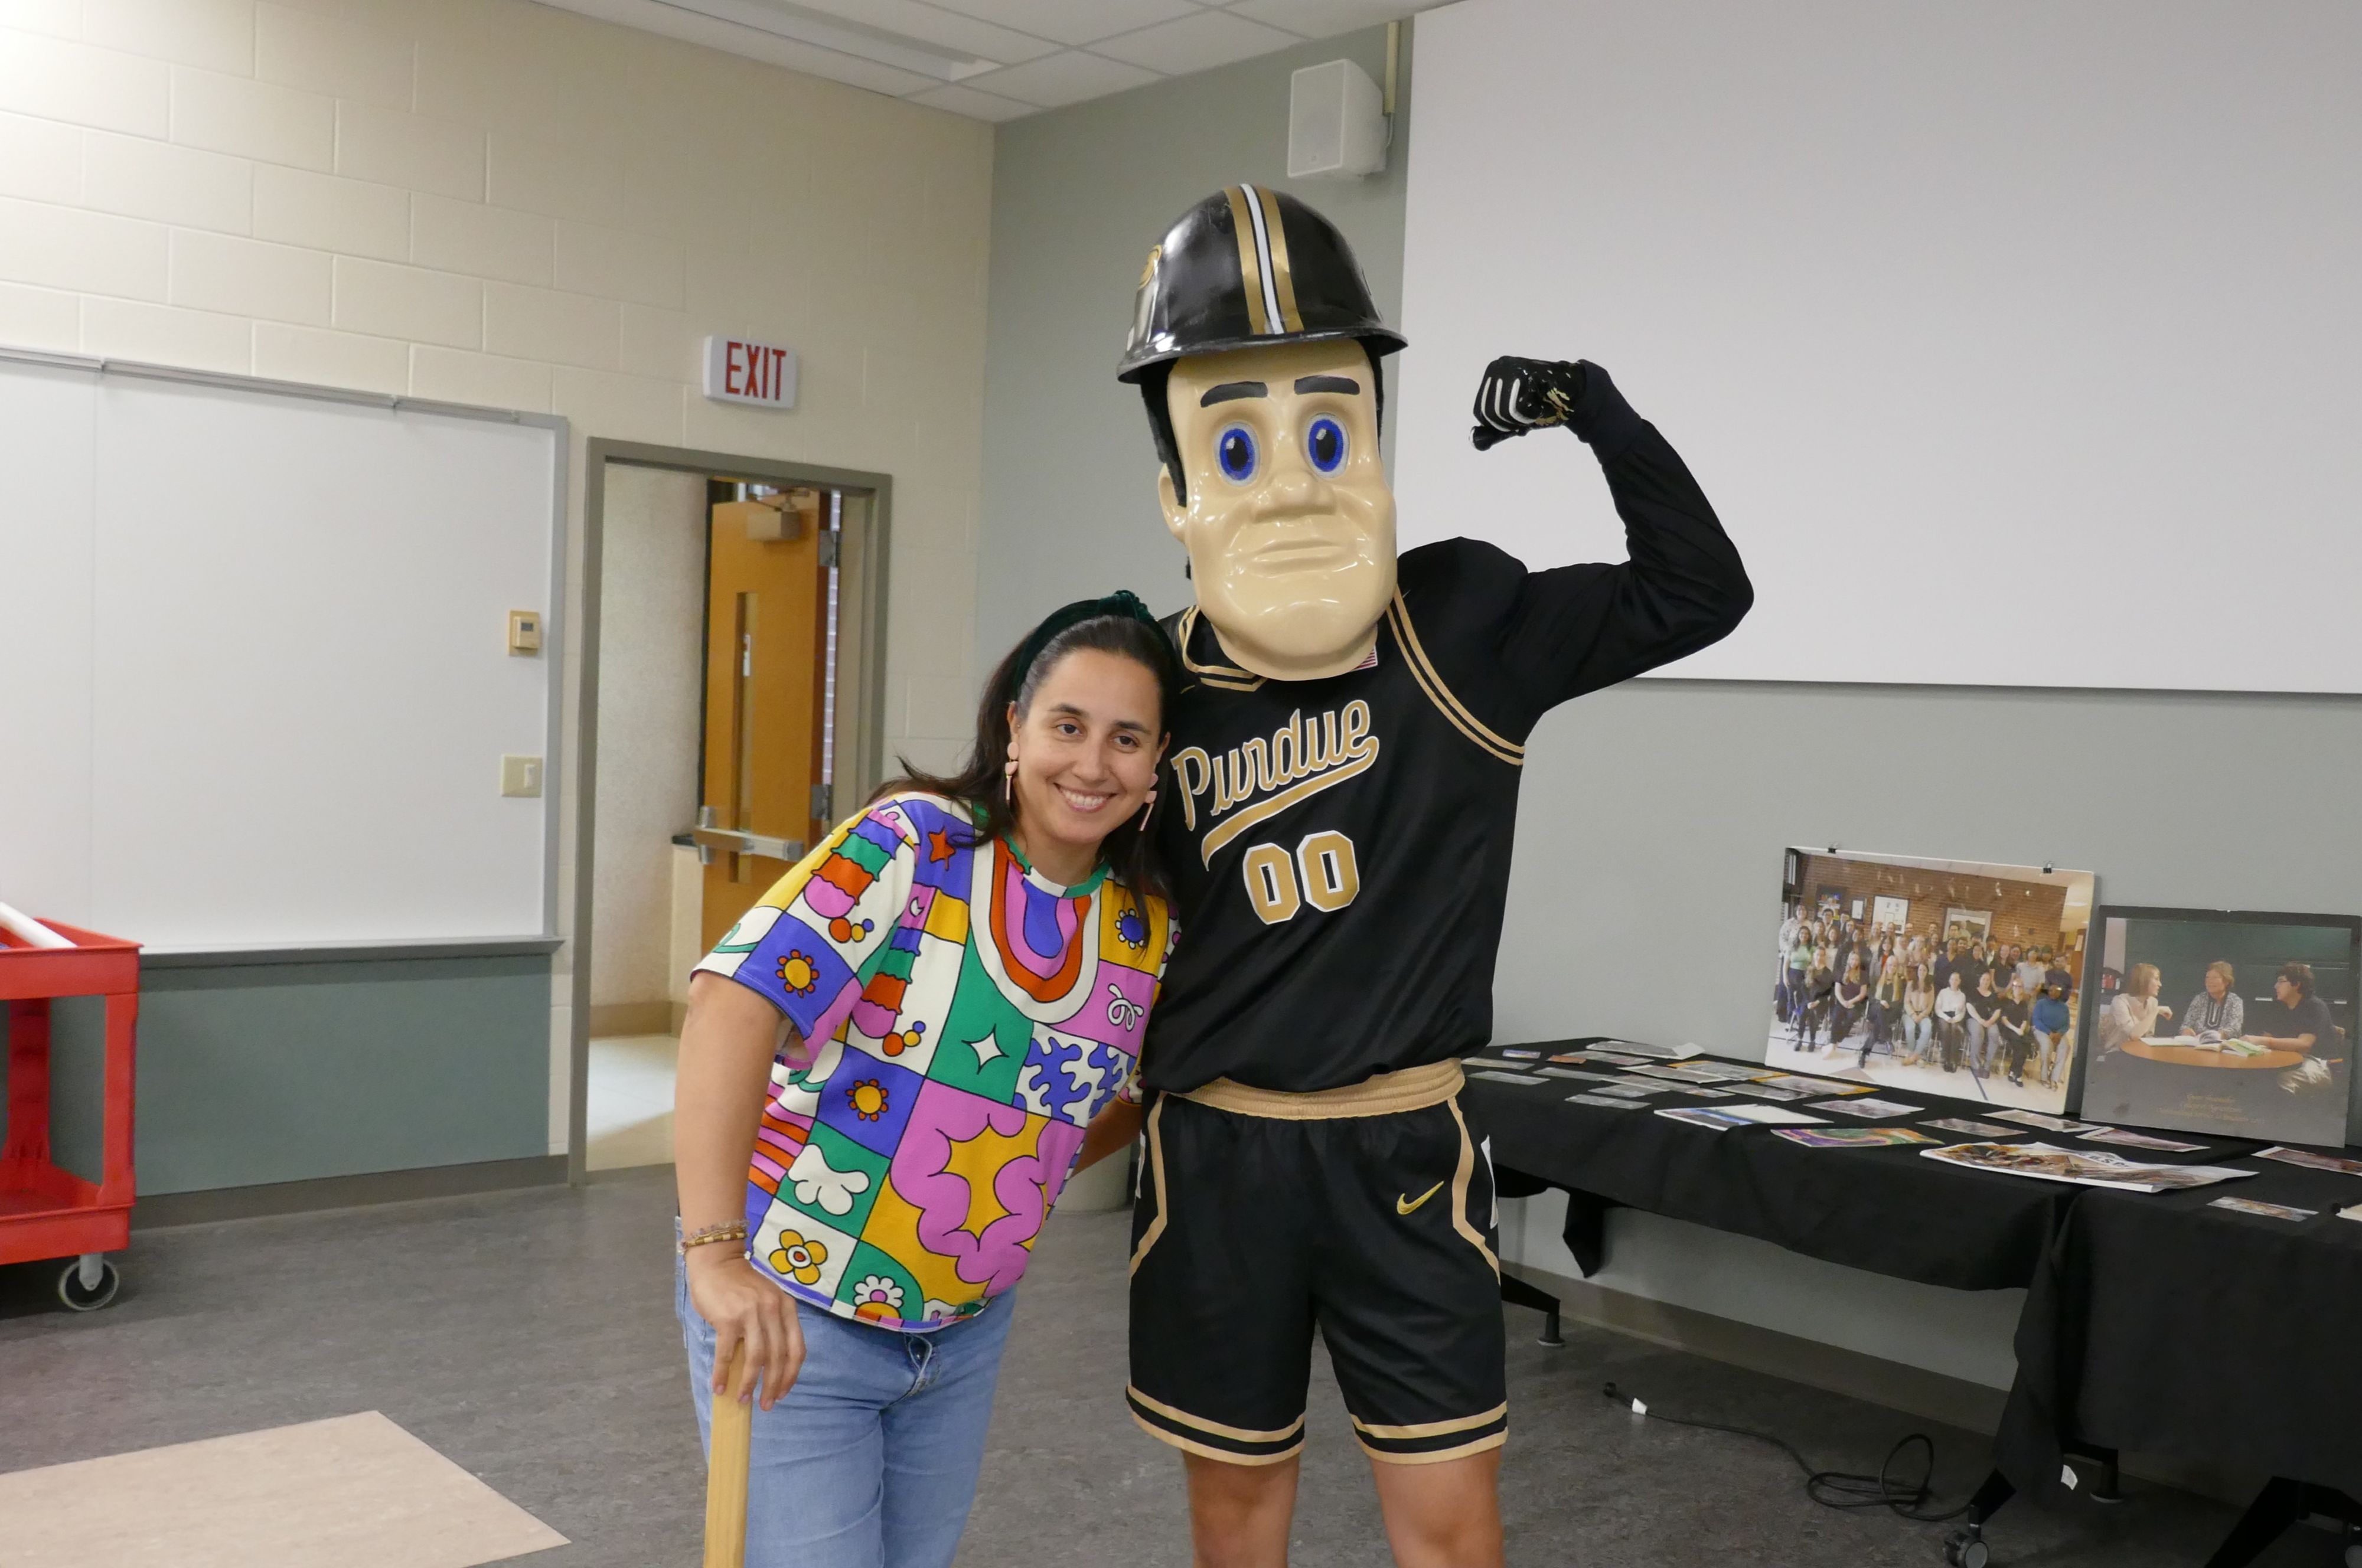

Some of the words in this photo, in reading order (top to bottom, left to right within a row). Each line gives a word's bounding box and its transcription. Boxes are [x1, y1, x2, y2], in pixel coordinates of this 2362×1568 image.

[725, 341, 787, 401] EXIT
[1170, 700, 1379, 832] Purdue
[1242, 830, 1359, 925] 00
